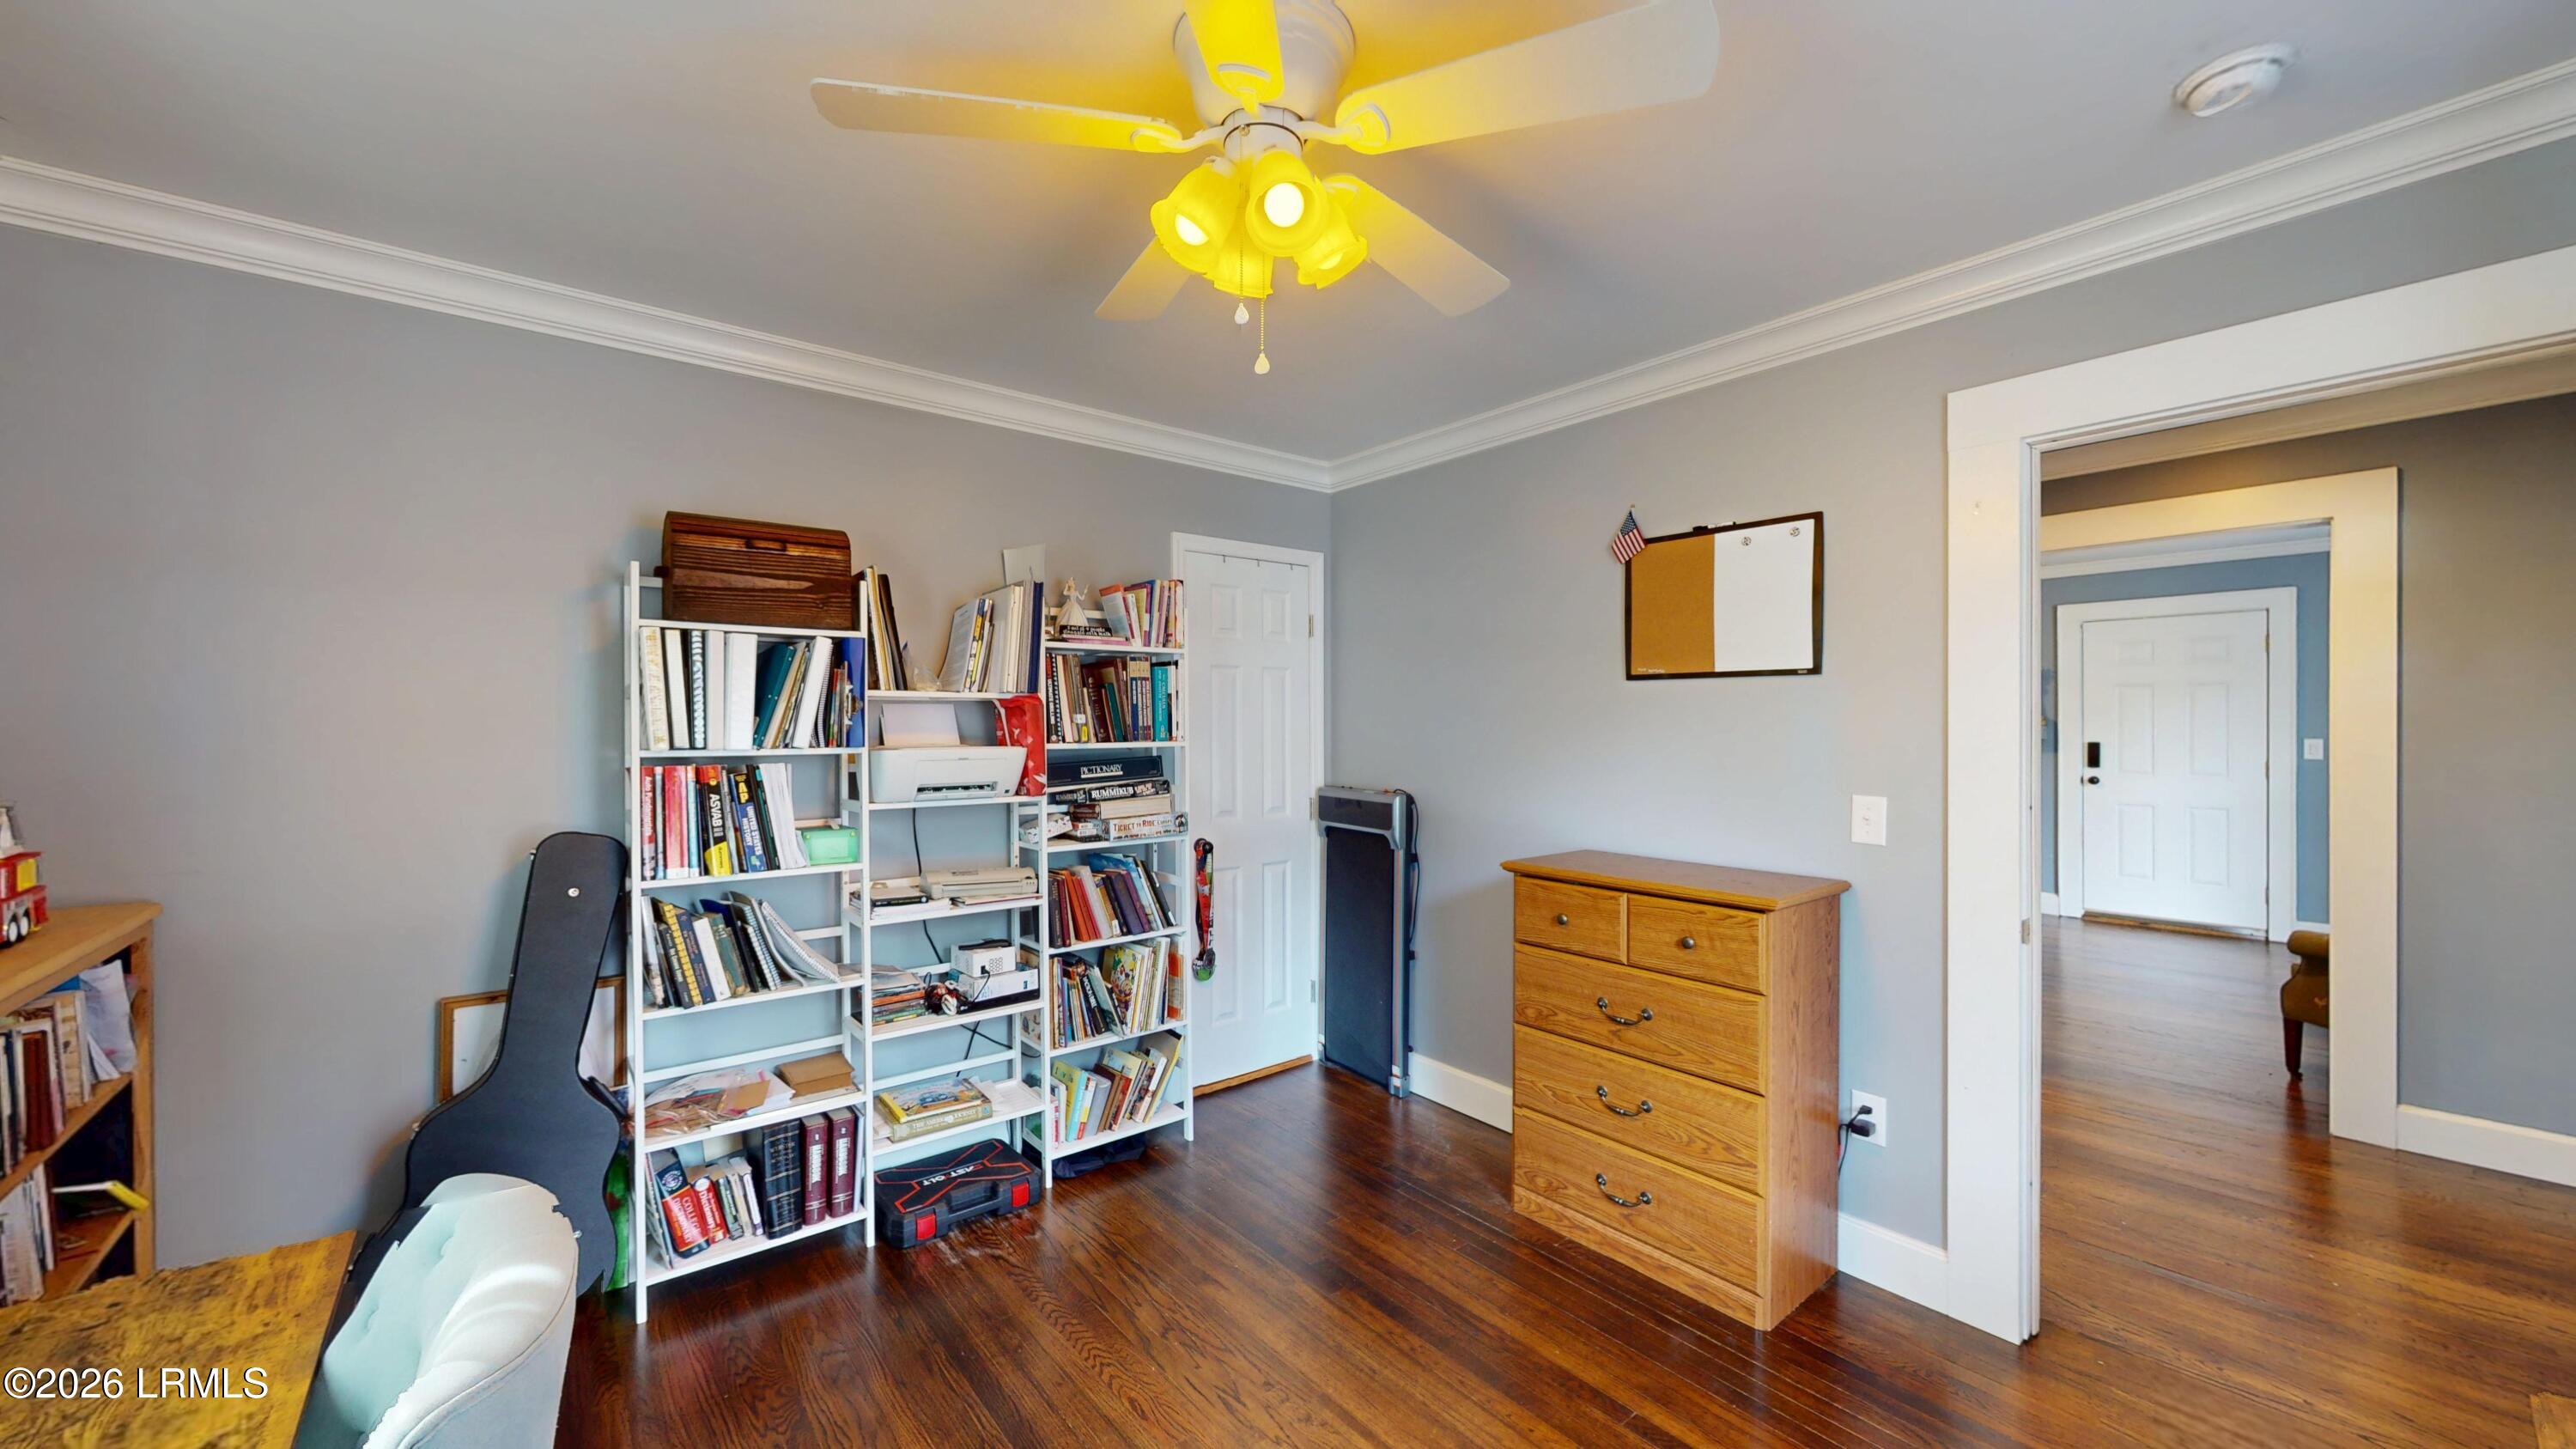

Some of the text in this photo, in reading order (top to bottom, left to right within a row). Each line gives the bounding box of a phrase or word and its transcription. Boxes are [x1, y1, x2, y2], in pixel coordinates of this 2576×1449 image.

[1080, 764, 1122, 775] PICTIONARY
[738, 782, 749, 803] AP
[1091, 786, 1134, 799] RUMMIKUB
[645, 791, 653, 837] Fundamentals
[709, 794, 722, 826] ASVAB
[742, 818, 753, 846] HISTORY
[746, 806, 763, 855] UNITED STATES
[1113, 822, 1134, 832] TICKET
[672, 1197, 693, 1243] DICTIONARY
[682, 1196, 702, 1233] COLLEGE
[699, 1190, 715, 1228] Dictionary
